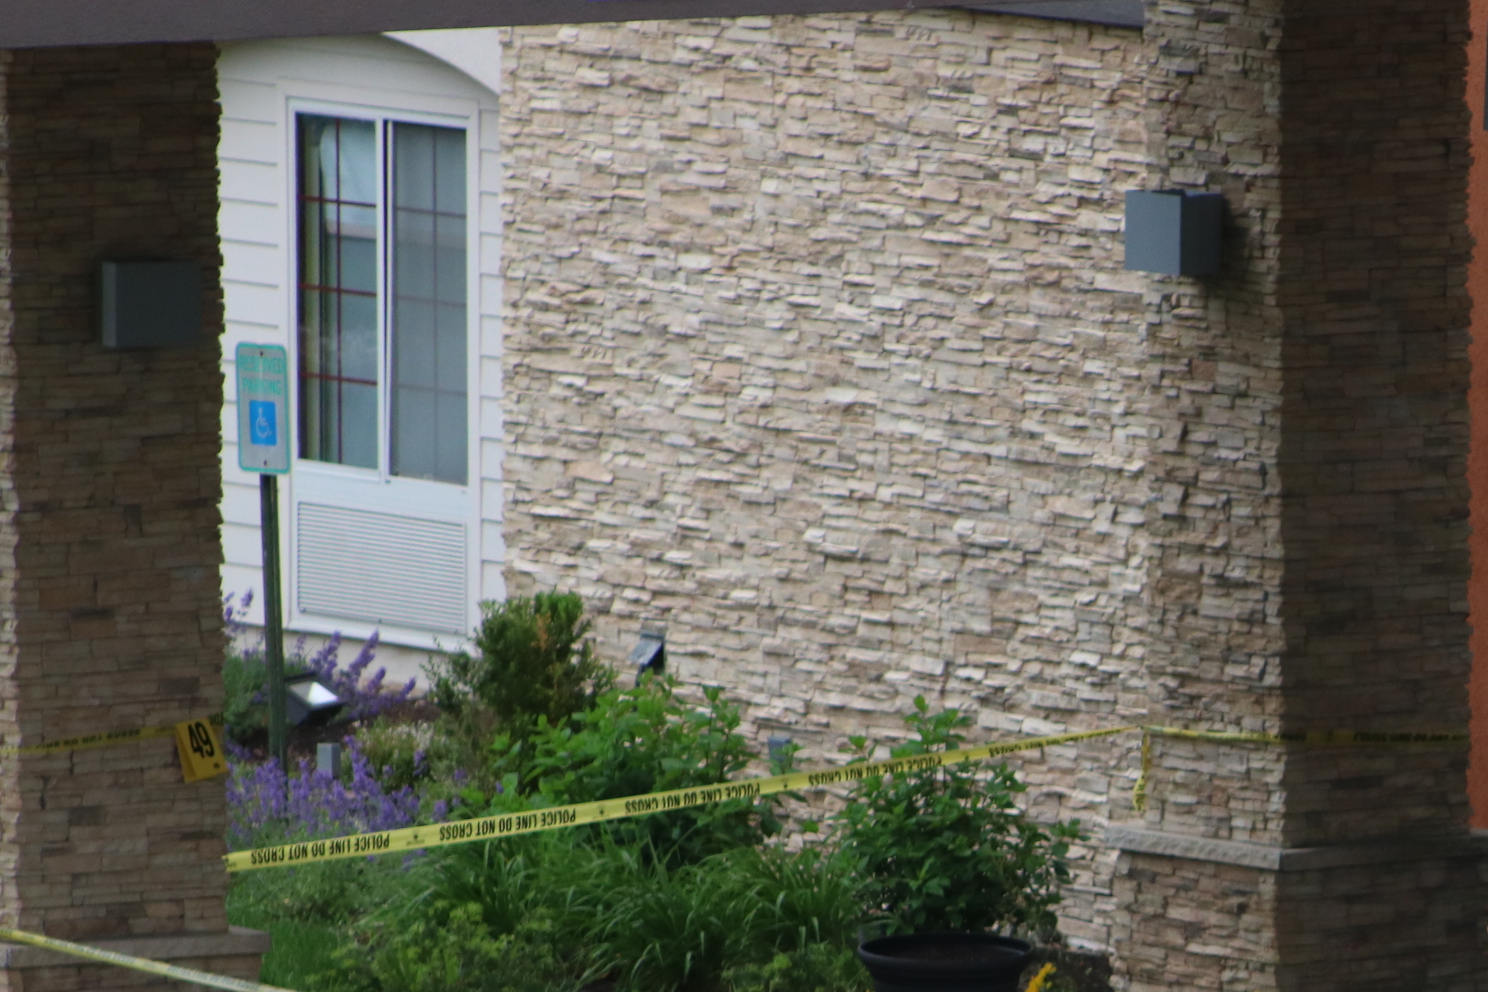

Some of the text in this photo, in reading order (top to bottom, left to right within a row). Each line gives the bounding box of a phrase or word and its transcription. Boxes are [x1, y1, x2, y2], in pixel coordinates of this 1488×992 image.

[187, 721, 215, 759] 49
[683, 791, 696, 806] DO
[701, 787, 721, 804] LINE
[725, 781, 760, 800] POLICE
[625, 796, 658, 813] CROSS
[439, 807, 576, 840] POLICE LINE DO NOT CROSS
[311, 841, 325, 857] DO
[329, 837, 350, 854] LINE
[354, 832, 389, 852] POLICE
[251, 846, 284, 864] CROSS
[288, 843, 307, 859] NOT
